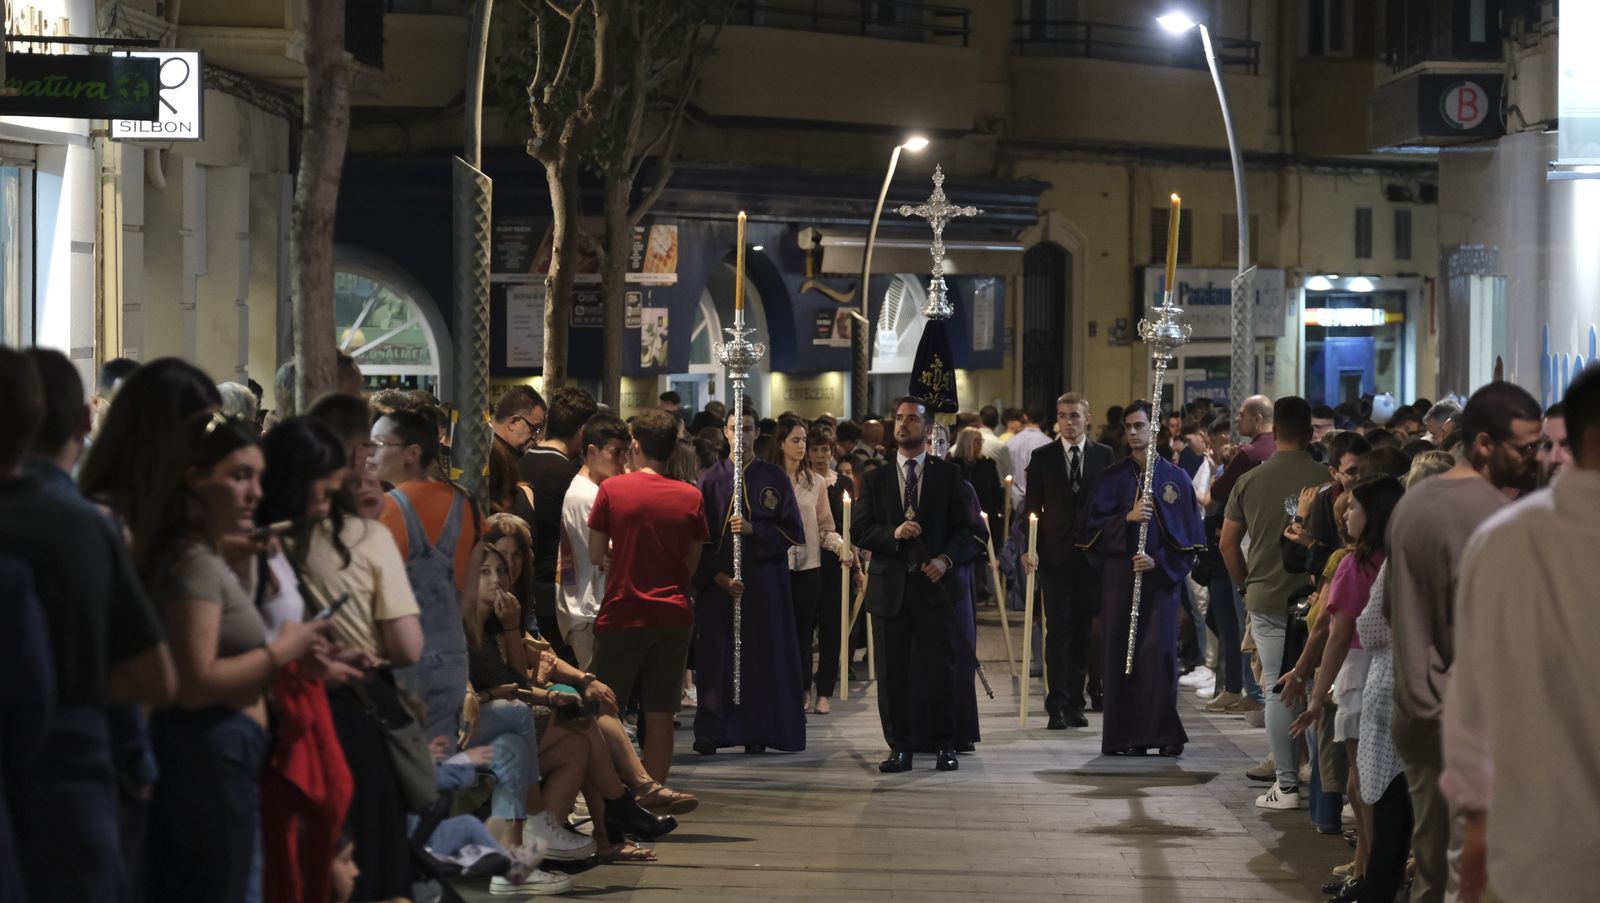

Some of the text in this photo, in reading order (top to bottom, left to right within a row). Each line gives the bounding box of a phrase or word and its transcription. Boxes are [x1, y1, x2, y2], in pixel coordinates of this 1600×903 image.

[5, 75, 112, 99] natura
[1457, 87, 1478, 122] B
[120, 121, 192, 133] SILBON
